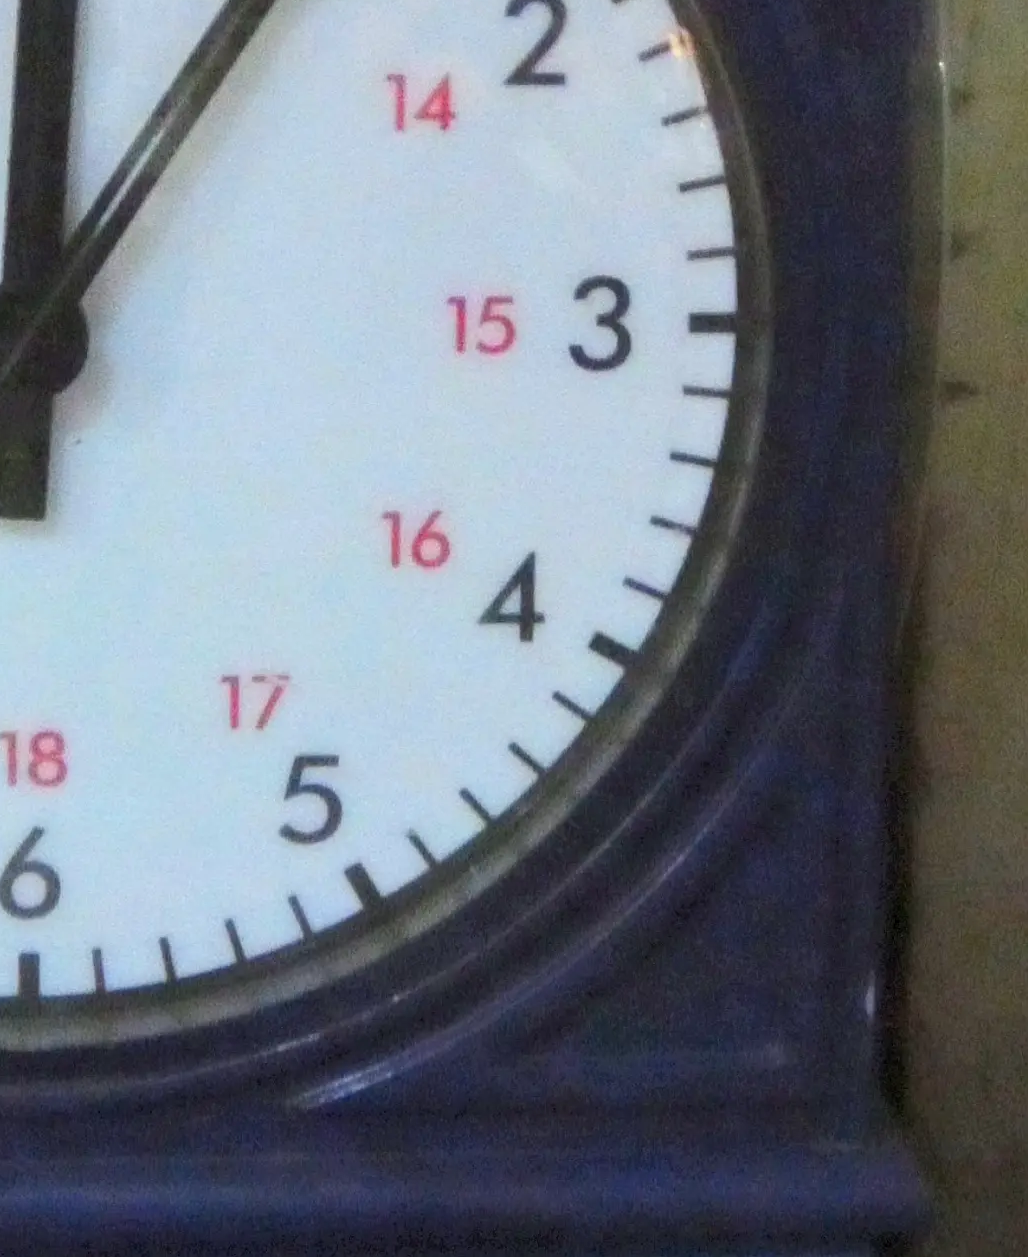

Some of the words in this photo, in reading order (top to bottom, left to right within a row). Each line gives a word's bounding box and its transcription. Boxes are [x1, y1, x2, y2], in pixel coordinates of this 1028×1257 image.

[387, 74, 457, 131] 14
[448, 295, 517, 354] 15
[568, 275, 633, 372] 3
[383, 509, 452, 568] 16
[479, 552, 546, 643] 4
[220, 674, 291, 730] 17
[0, 729, 68, 787] 18
[280, 754, 343, 844] 5
